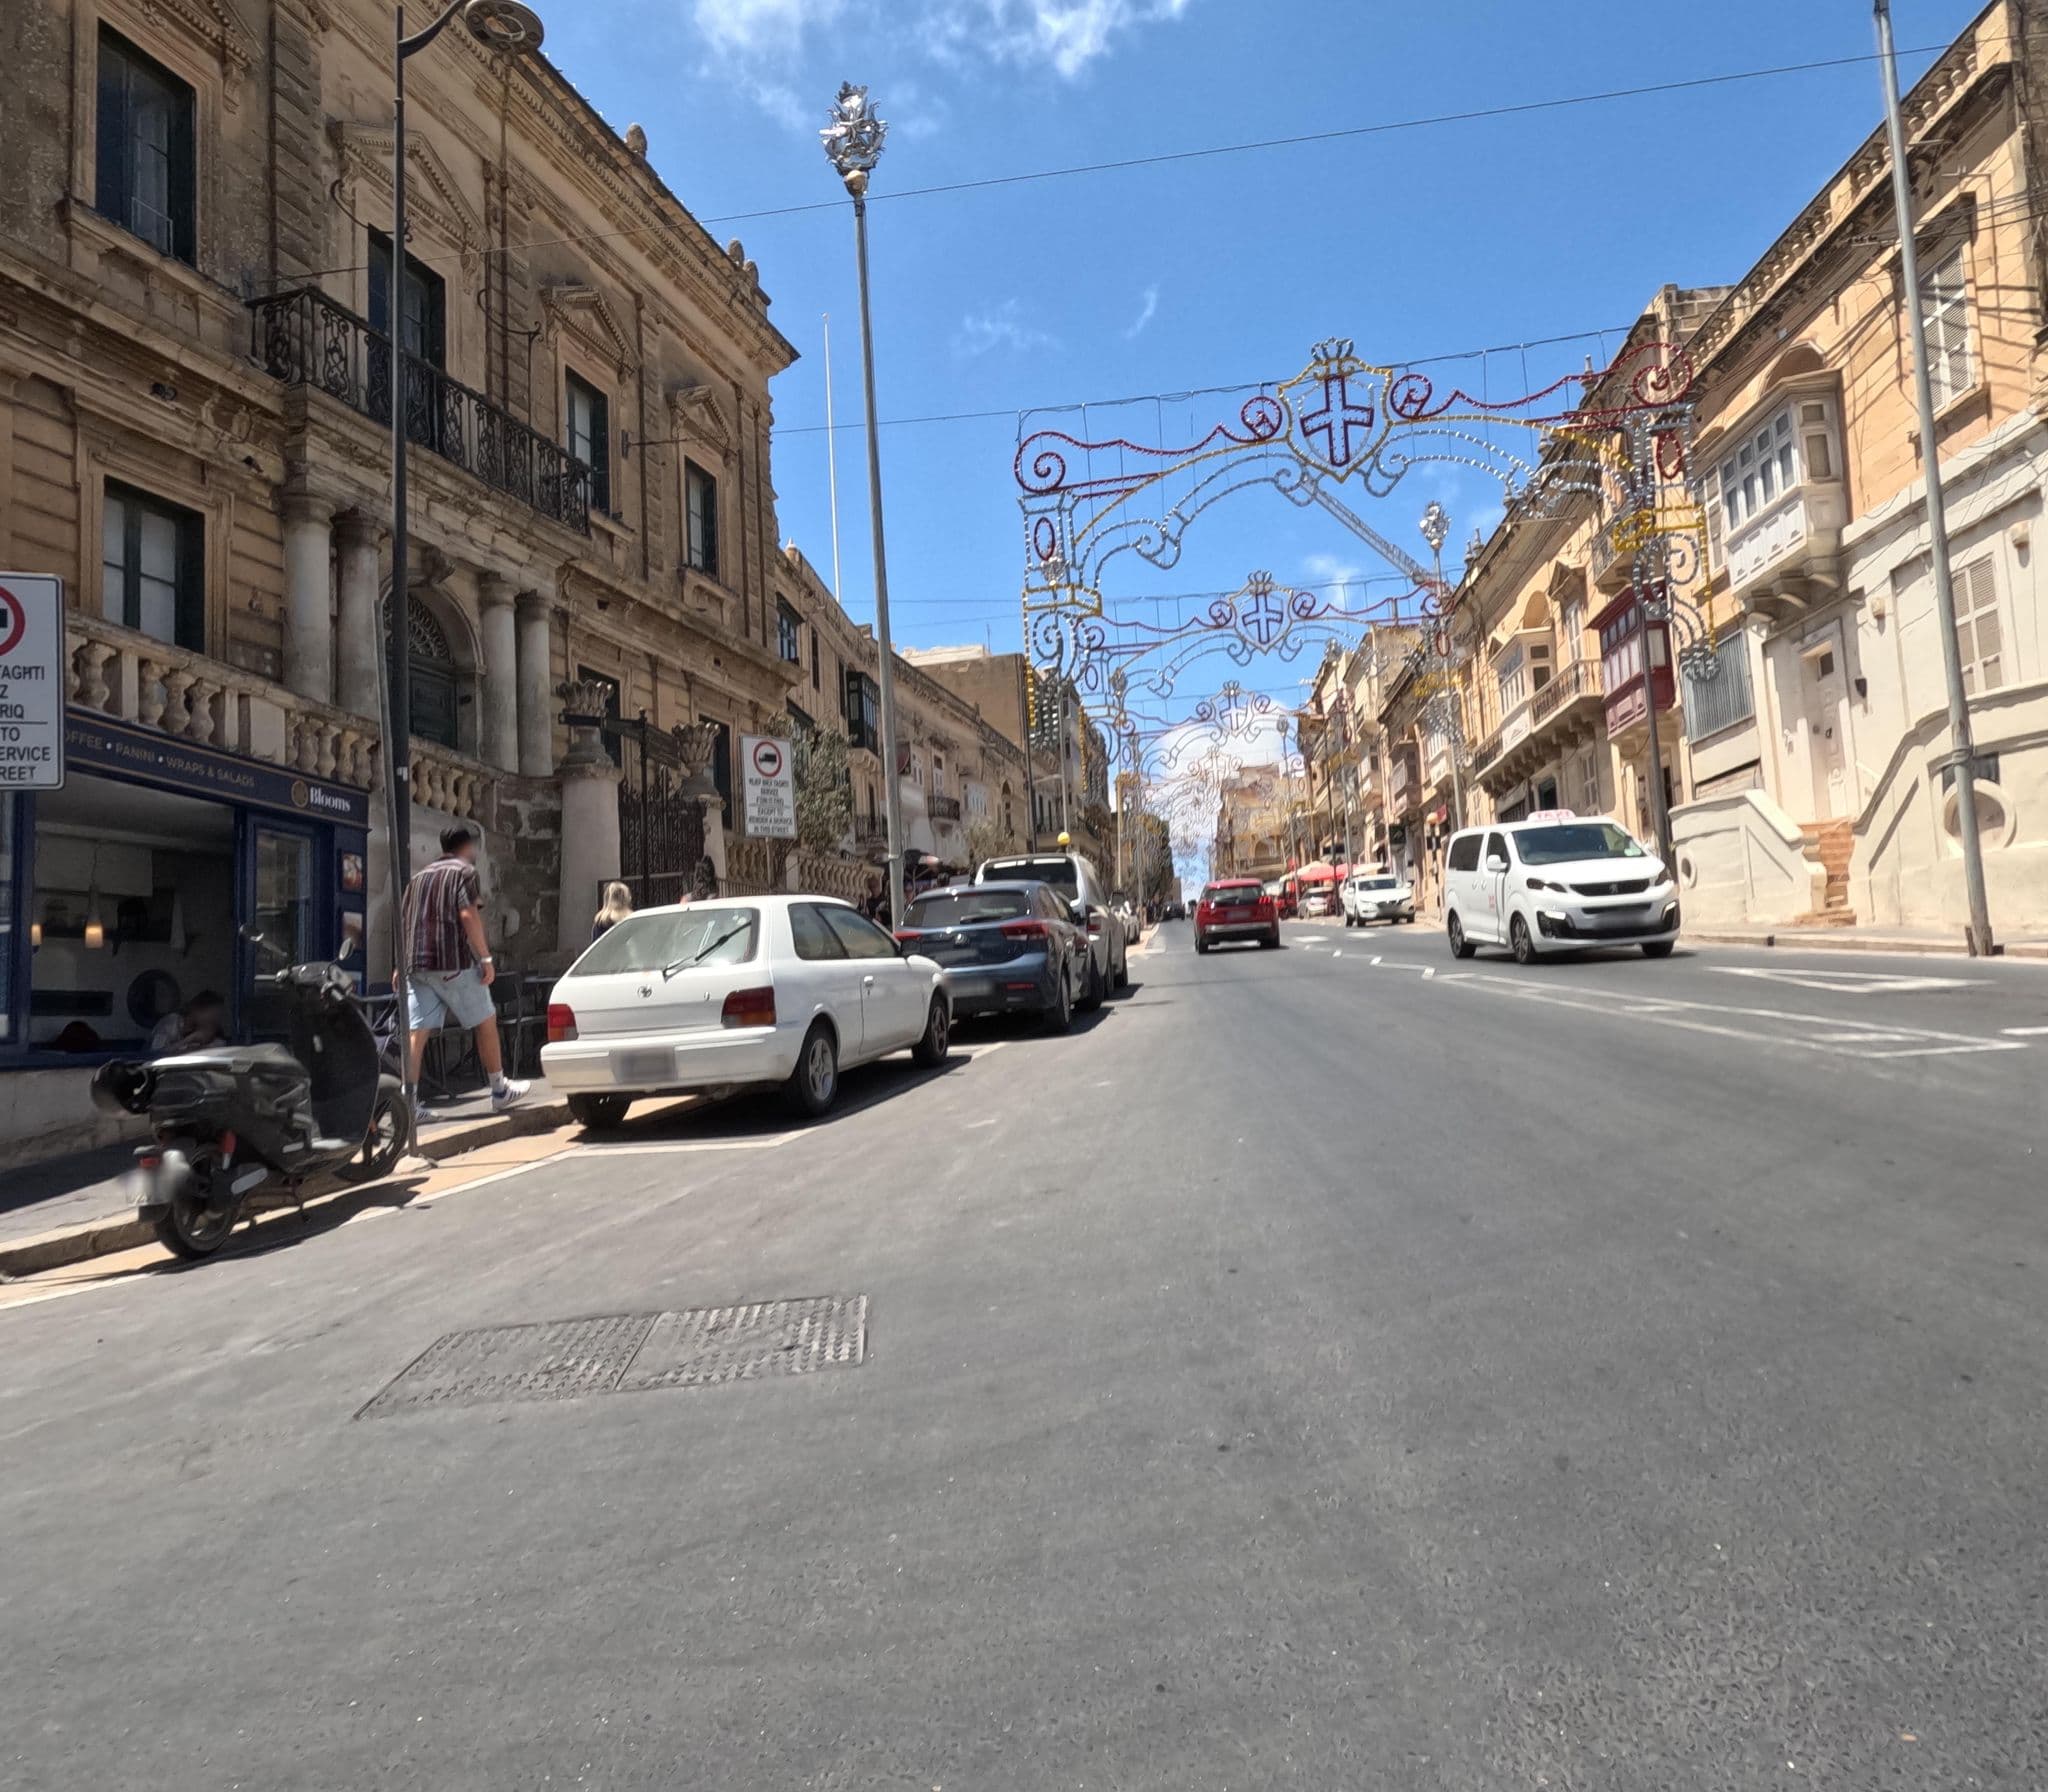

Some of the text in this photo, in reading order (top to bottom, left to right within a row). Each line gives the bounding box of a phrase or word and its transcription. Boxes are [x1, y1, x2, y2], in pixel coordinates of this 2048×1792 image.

[0, 726, 21, 741] TO
[166, 755, 206, 777] WRAPS
[310, 786, 351, 812] Blooms
